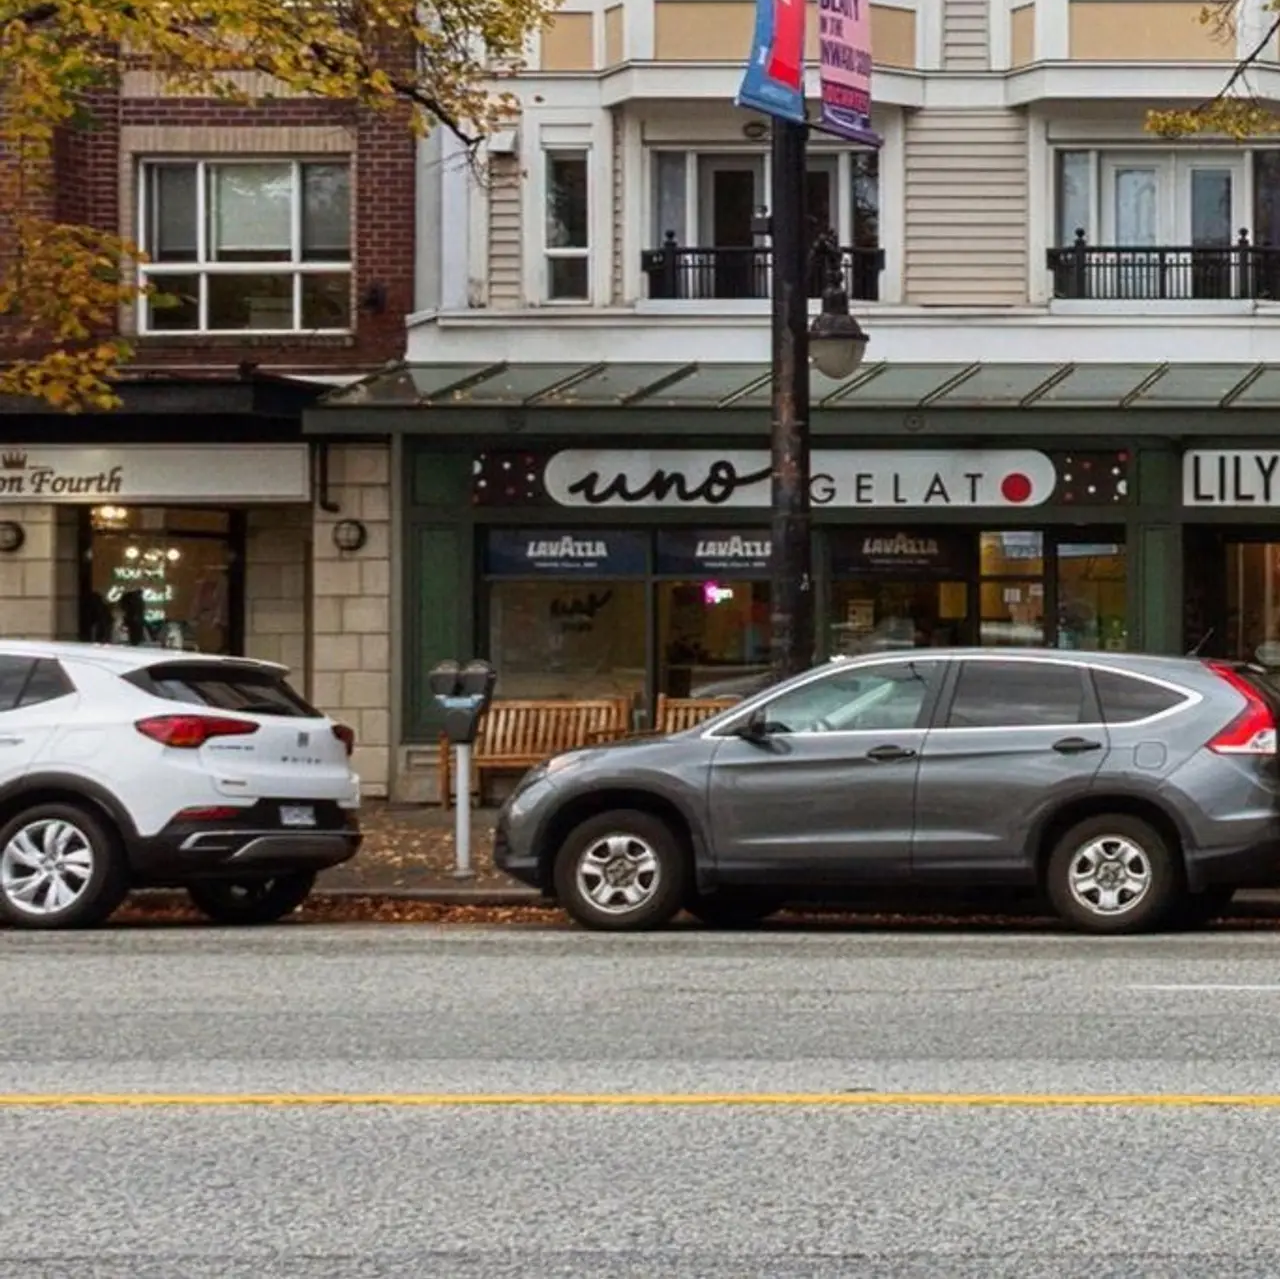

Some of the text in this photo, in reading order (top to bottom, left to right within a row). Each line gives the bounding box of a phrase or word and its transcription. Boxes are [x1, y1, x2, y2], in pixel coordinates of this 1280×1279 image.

[28, 466, 123, 493] Fourth
[568, 460, 772, 503] uno
[1193, 454, 1279, 502] LILY
[526, 536, 608, 558] LAVAZZA
[862, 532, 938, 555] LAVAZZA
